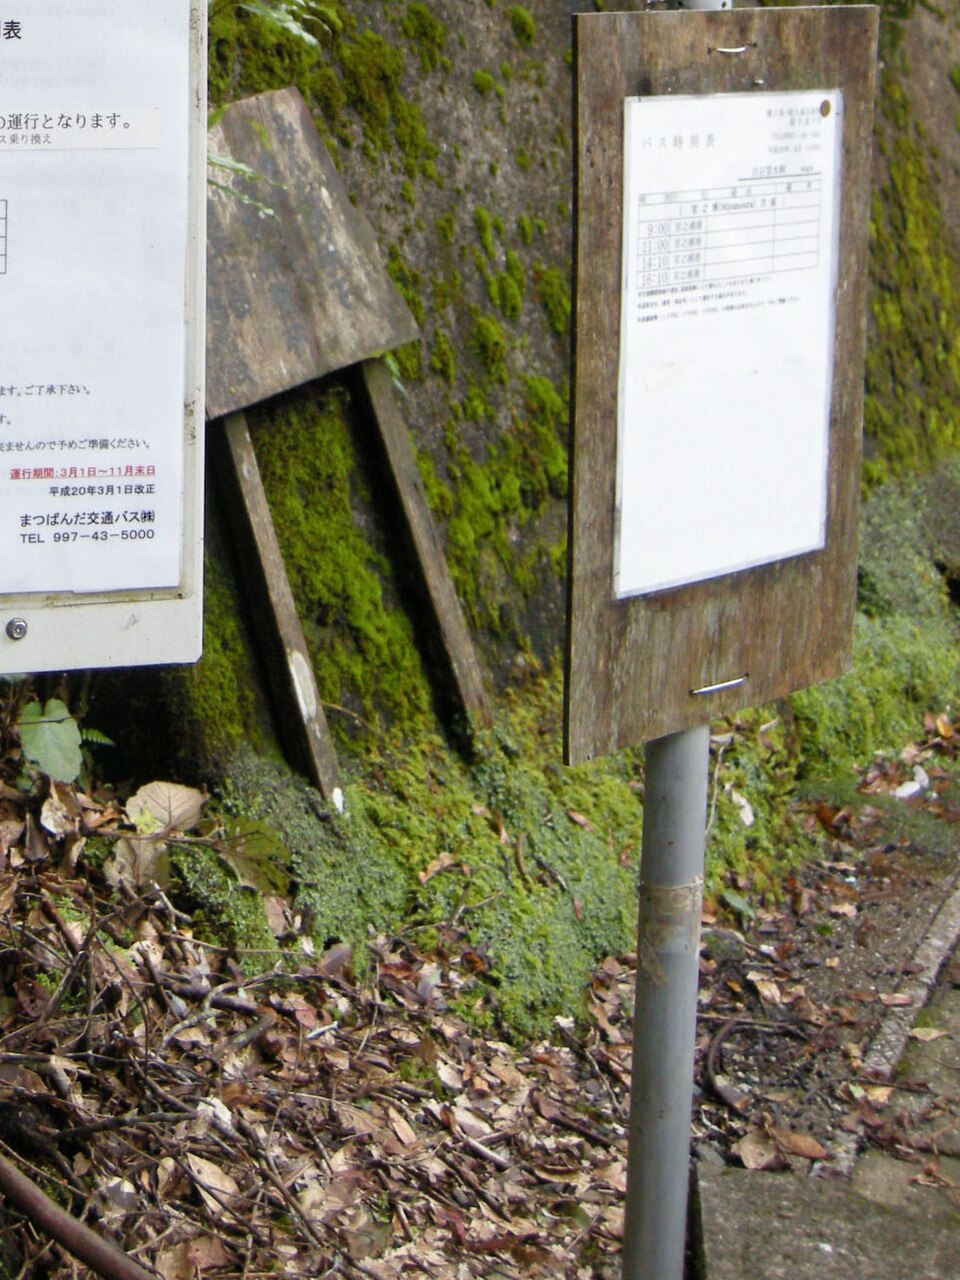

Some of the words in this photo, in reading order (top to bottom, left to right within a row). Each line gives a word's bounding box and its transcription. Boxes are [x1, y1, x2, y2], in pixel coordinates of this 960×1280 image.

[48, 484, 156, 497] 平成20年3月1日改正
[20, 533, 45, 545] TEL
[53, 528, 156, 543] 997-43-5000
